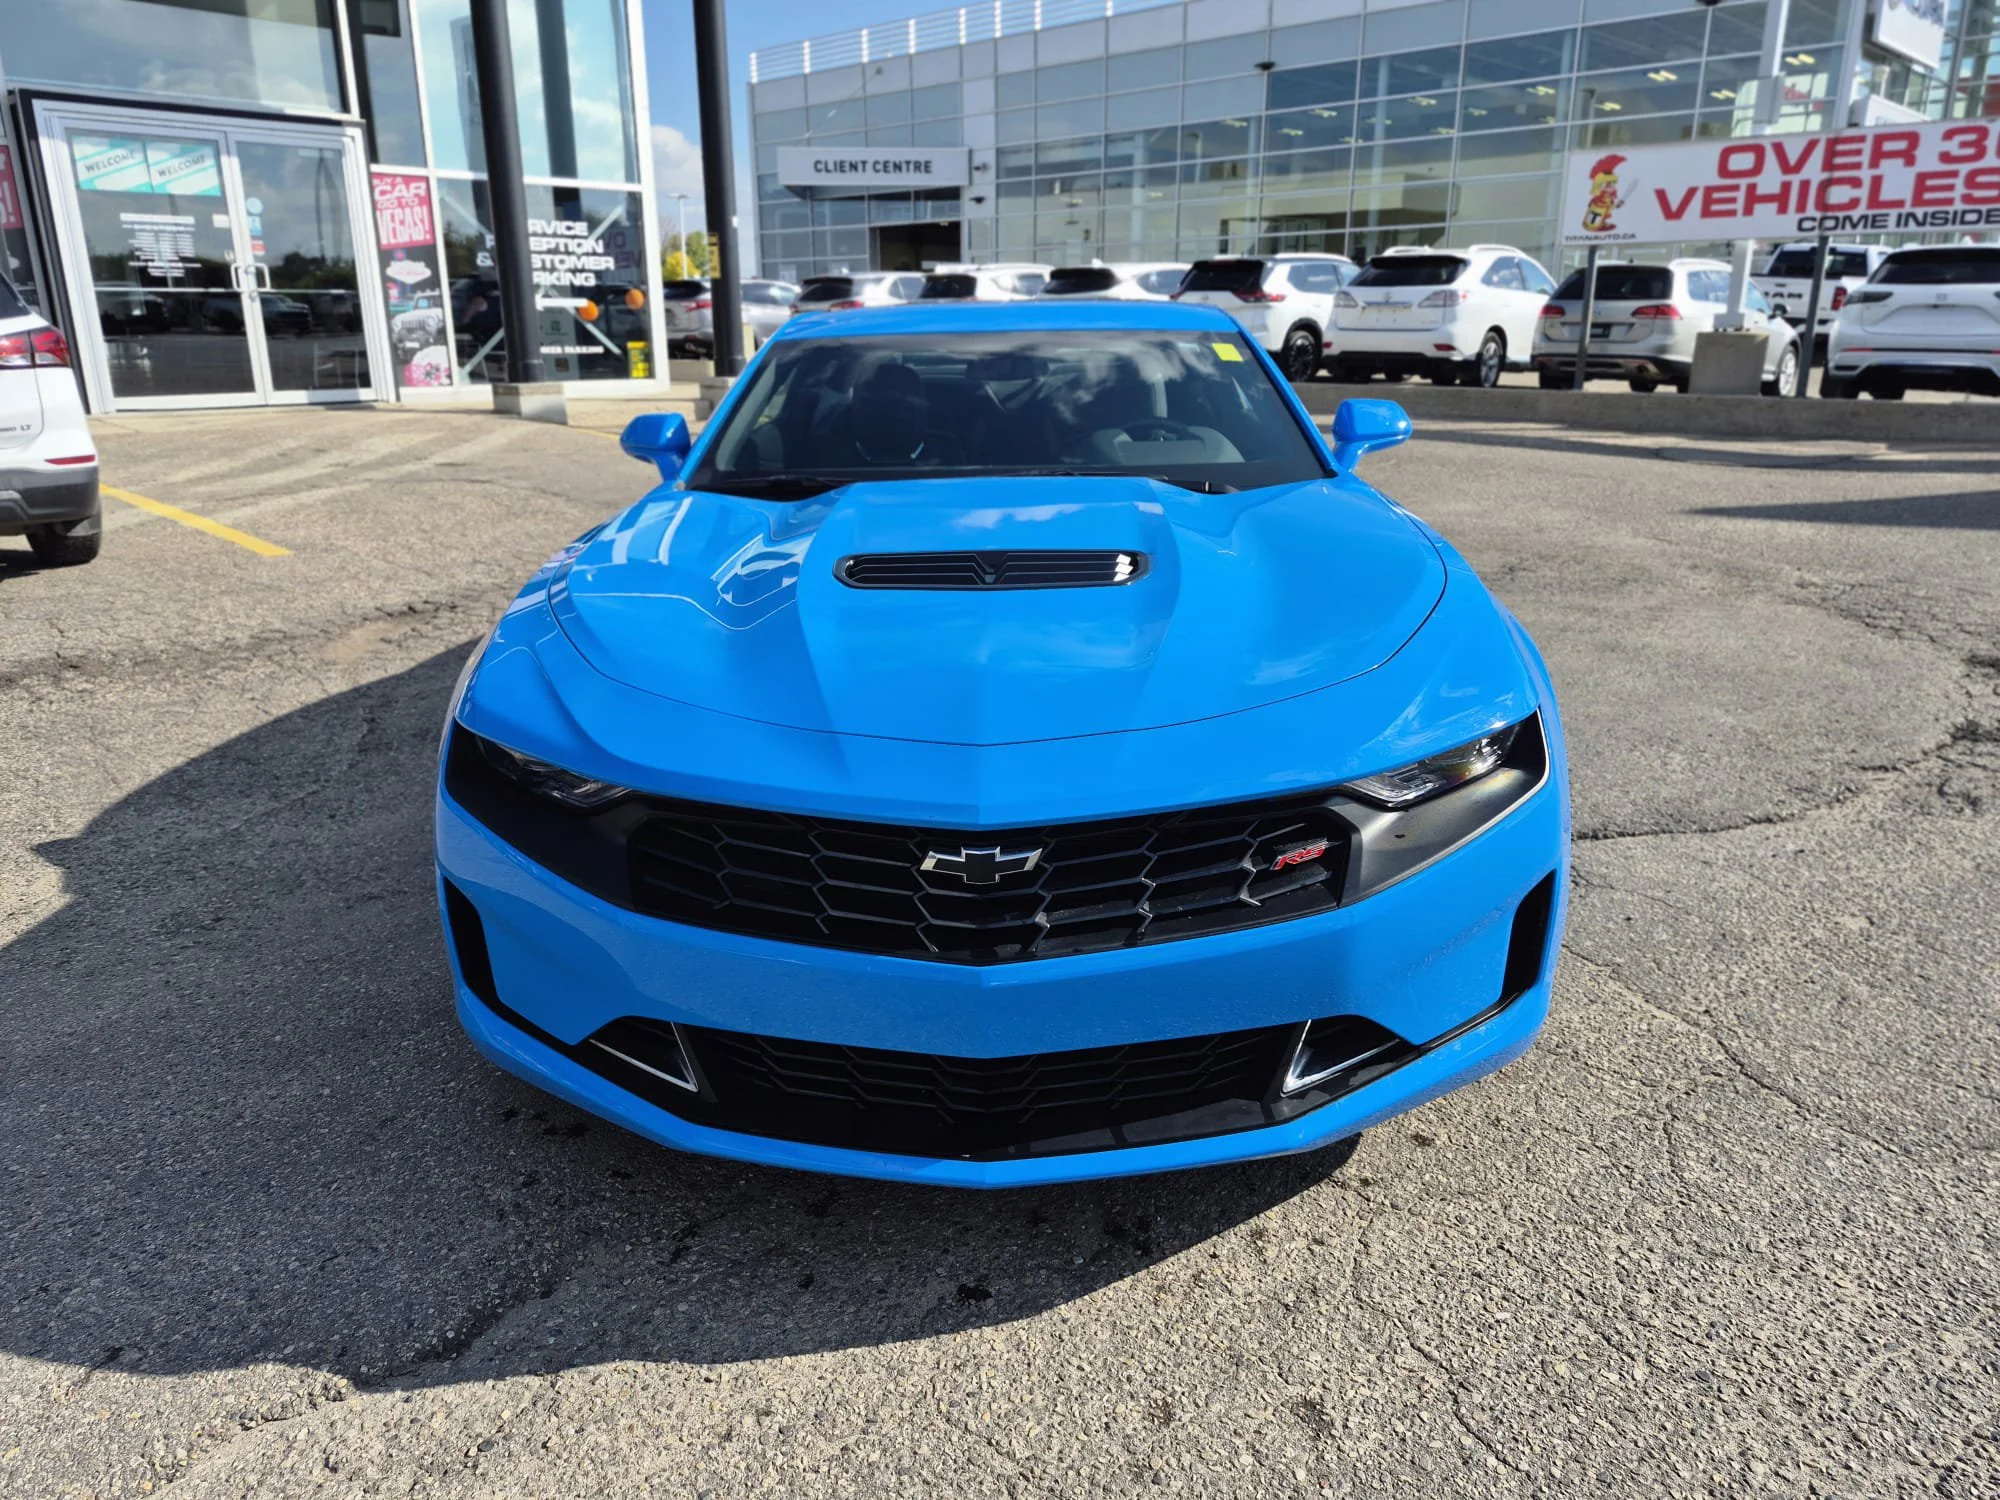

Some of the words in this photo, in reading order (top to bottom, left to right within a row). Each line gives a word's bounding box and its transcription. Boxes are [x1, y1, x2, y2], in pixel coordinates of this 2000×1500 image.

[84, 150, 136, 173] WELCOME
[1717, 130, 1920, 180] OVER
[1938, 125, 2000, 165] 3
[157, 155, 206, 177] WELCOME
[814, 159, 868, 174] CLIENT
[872, 159, 933, 174] CENTRE
[374, 182, 428, 200] CAR
[1654, 167, 2000, 222] VEHICLES
[377, 205, 430, 244] VEGAS!
[527, 218, 589, 236] RVICE
[1797, 213, 1890, 233] COME
[1895, 208, 2000, 229] INSIDE
[476, 252, 494, 267] &
[530, 253, 616, 271] STOMER
[532, 271, 597, 287] RKING
[1270, 840, 1329, 871] RS
